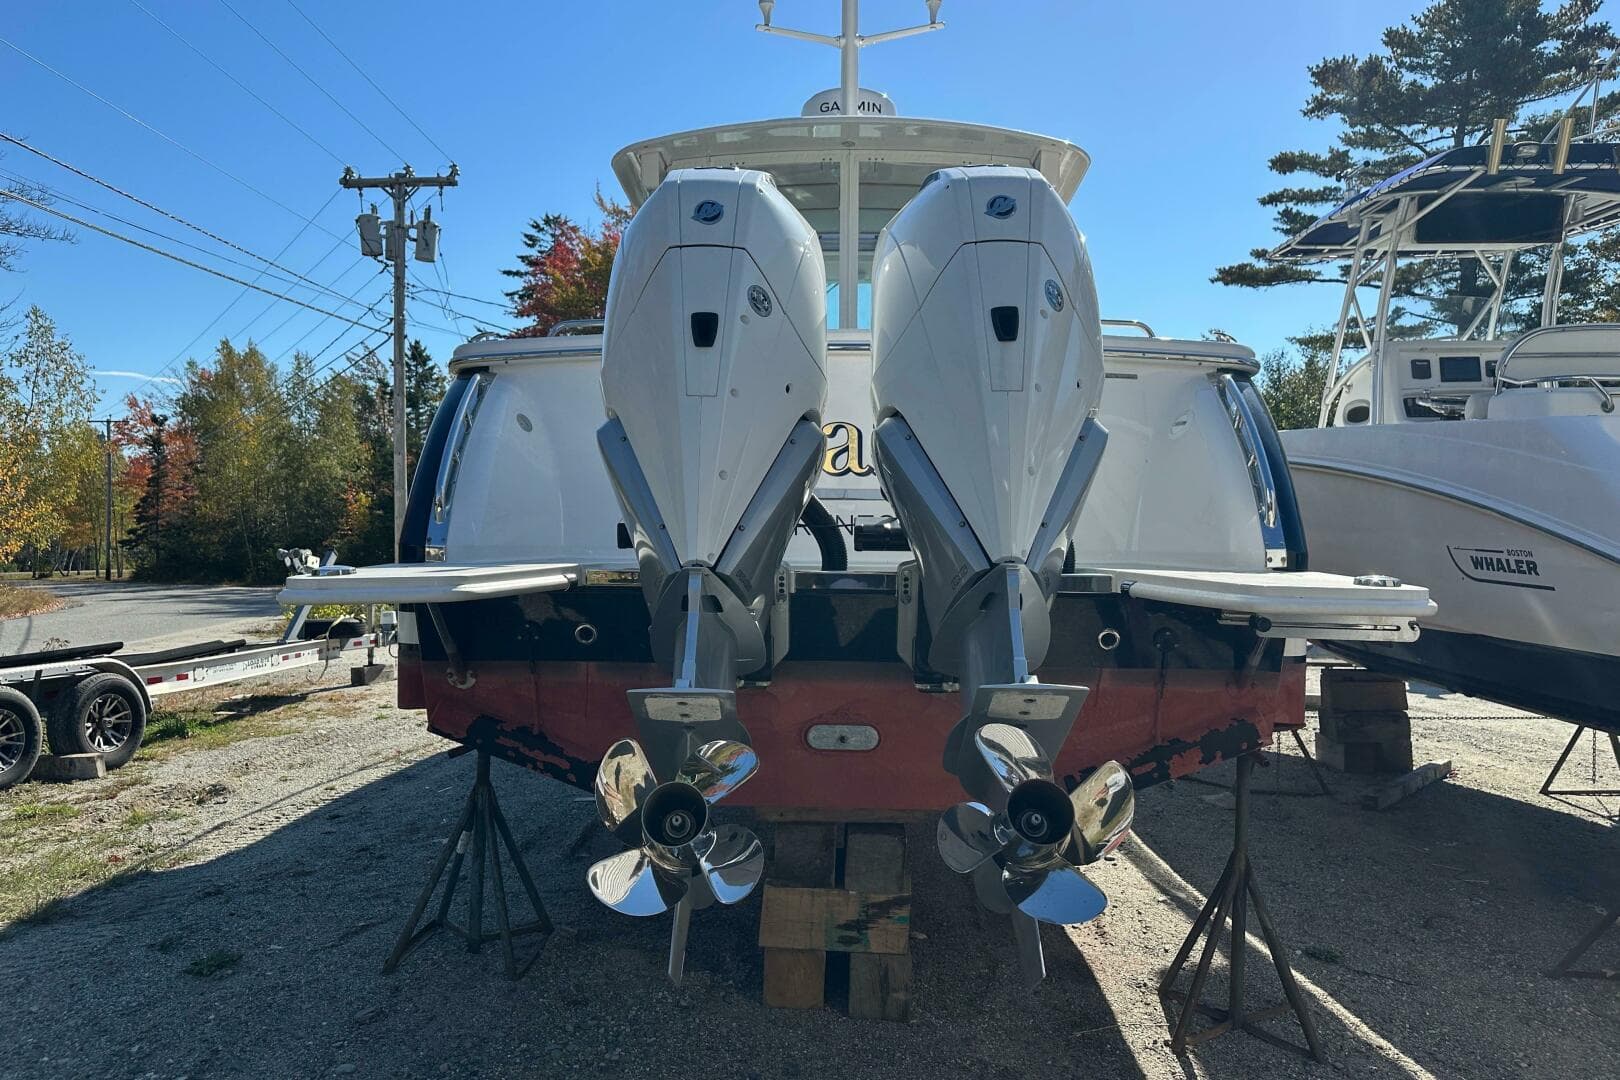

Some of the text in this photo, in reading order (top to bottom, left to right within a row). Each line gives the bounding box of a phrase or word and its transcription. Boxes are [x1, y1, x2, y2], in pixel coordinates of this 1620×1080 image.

[819, 101, 882, 114] GAMIN
[1506, 548, 1534, 558] BOSTON
[1469, 555, 1541, 577] WHALER
